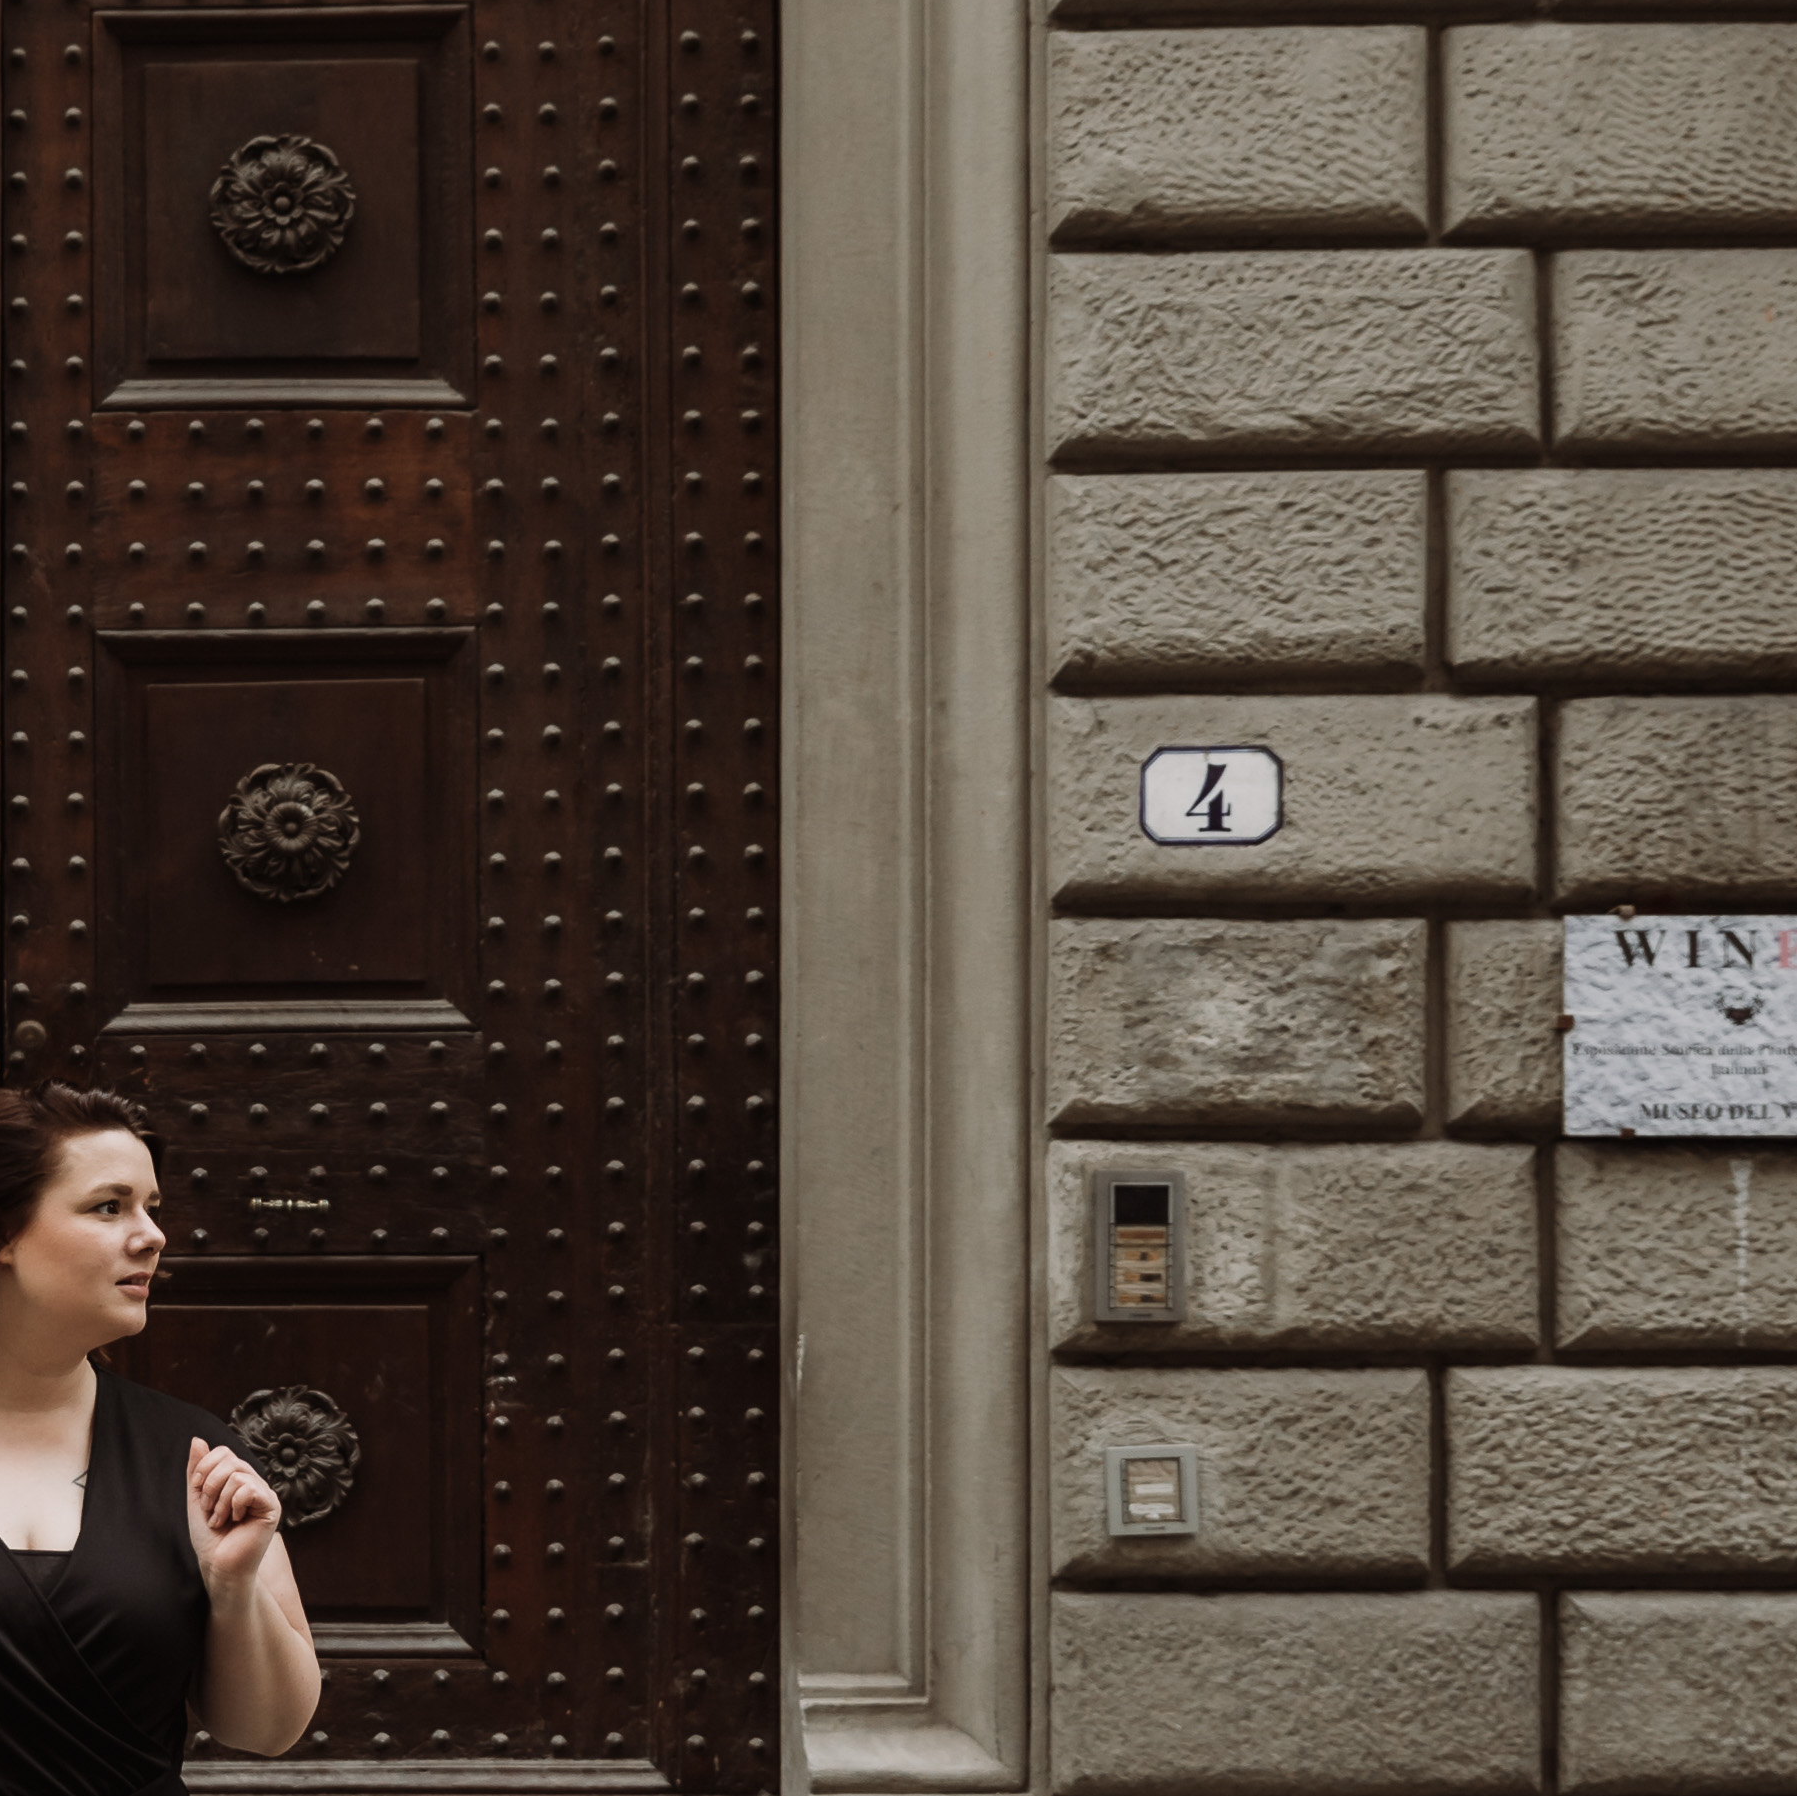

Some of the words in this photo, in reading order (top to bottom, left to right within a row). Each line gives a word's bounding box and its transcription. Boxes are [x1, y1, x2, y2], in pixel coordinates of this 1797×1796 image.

[1185, 763, 1232, 832] 4
[1639, 1103, 1723, 1121] MUSEO
[1729, 1103, 1774, 1120] DEL
